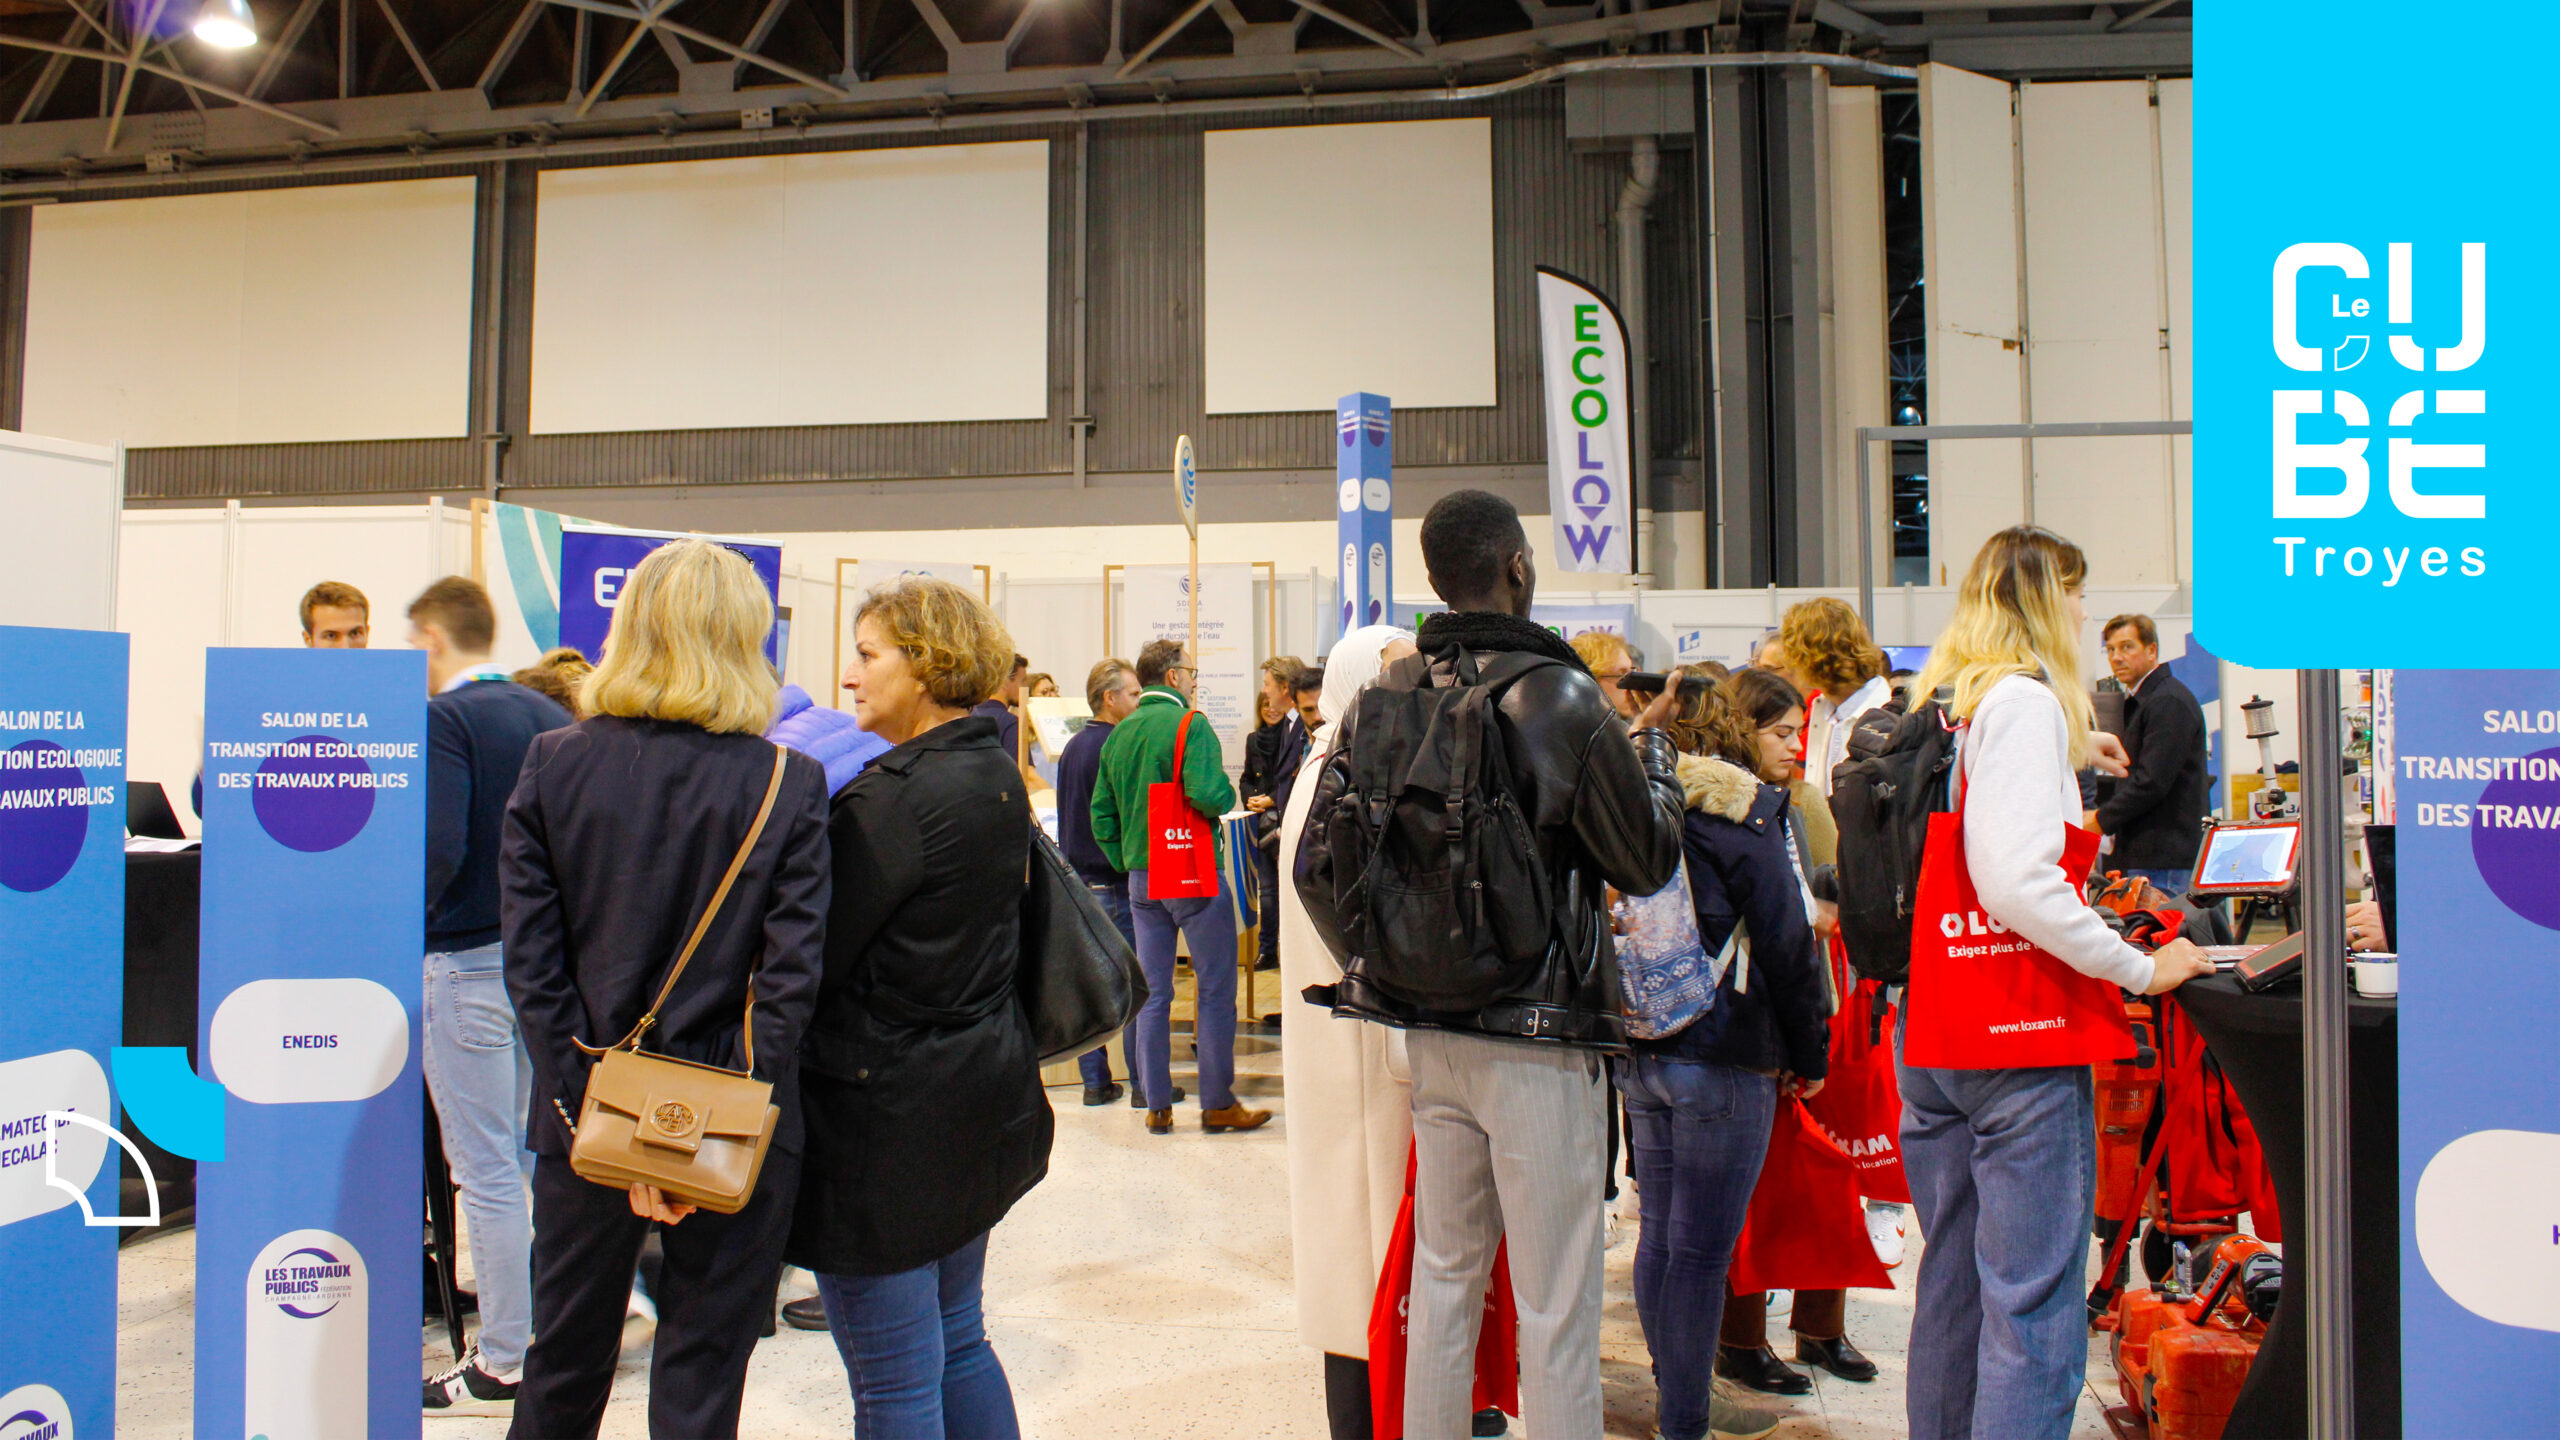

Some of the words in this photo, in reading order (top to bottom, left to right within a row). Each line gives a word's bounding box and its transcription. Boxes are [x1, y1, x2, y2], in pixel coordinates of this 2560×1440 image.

[1562, 304, 1613, 564] ECOLOW
[0, 710, 39, 730] ALON
[43, 711, 64, 730] DE
[66, 711, 85, 730] LA
[261, 712, 317, 728] SALON
[321, 712, 343, 728] DE
[347, 713, 369, 728] LA
[2483, 710, 2560, 733] SALO
[0, 749, 34, 769] TION
[37, 748, 123, 769] ECOLOGIQUE
[209, 742, 311, 758] TRANSITION
[314, 743, 419, 760] ECOLOGIQUE
[218, 773, 252, 788] DES
[255, 773, 335, 788] TRAVAUX
[338, 773, 409, 788] PUBLICS
[0, 788, 55, 810] AVAUX
[58, 785, 115, 807] PUBLICS
[2417, 803, 2471, 827] DES
[1948, 945, 1988, 959] Exigez
[1990, 943, 2015, 956] plus
[2016, 940, 2032, 952] de
[1989, 1016, 2067, 1035] www.loxam.fr
[283, 1034, 339, 1049] ENEDIS
[1862, 1157, 1898, 1169] location
[265, 1268, 288, 1281] LES
[290, 1264, 351, 1280] TRAVAUX
[265, 1280, 319, 1295] PUBLICS
